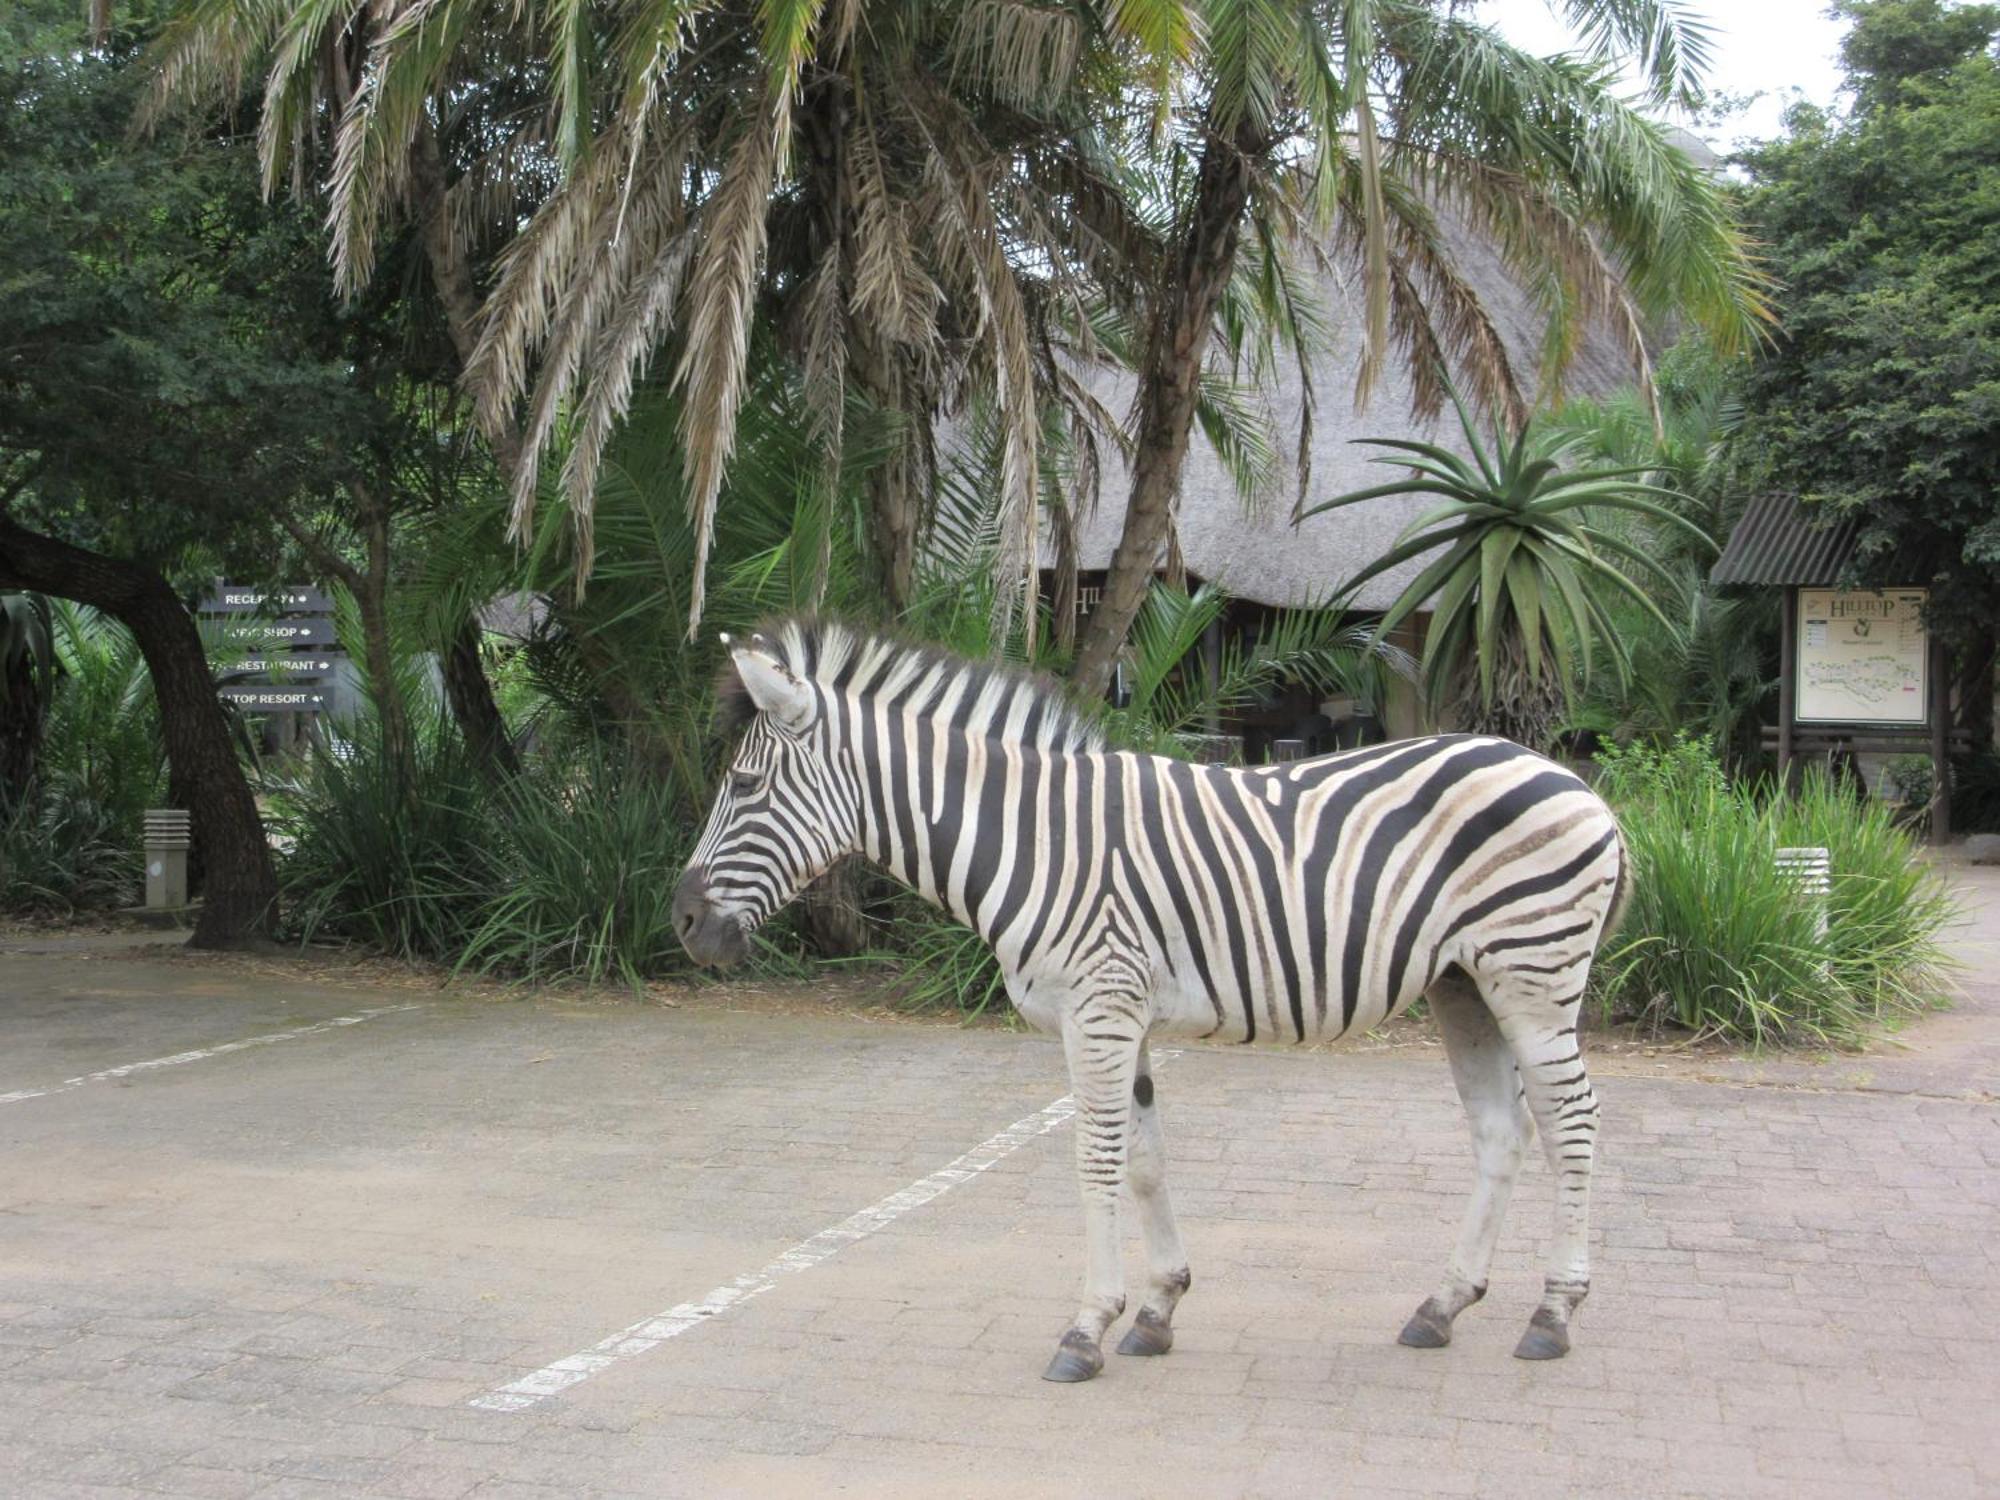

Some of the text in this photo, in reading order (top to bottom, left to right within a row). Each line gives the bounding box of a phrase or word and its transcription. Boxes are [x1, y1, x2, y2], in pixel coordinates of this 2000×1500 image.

[1831, 599, 1895, 617] HILLTOP
[263, 627, 297, 637] SHOP
[260, 694, 307, 703] RESORT
